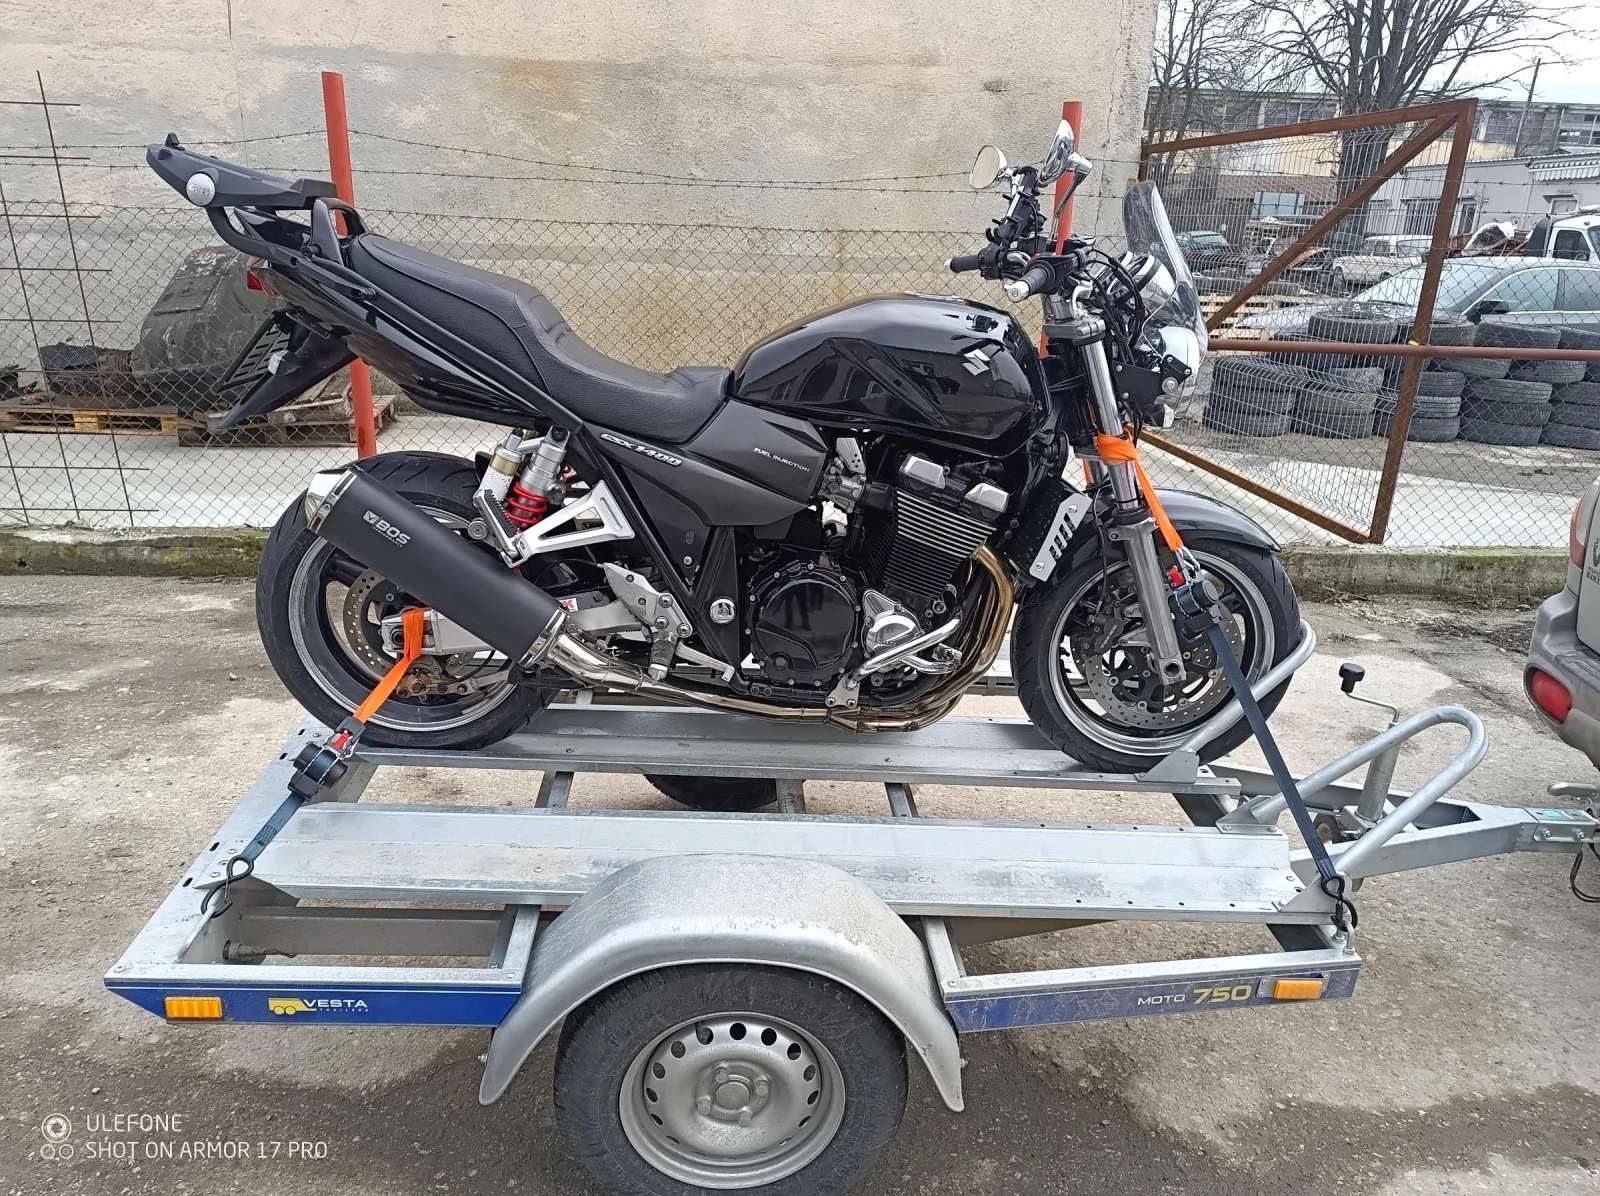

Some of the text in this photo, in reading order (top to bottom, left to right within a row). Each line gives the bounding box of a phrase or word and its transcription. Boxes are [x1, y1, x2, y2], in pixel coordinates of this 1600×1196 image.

[753, 447, 811, 472] FUEL INJECTION
[375, 519, 411, 545] BOS
[303, 999, 368, 1007] VESTA
[1137, 984, 1252, 1006] MOTO 750
